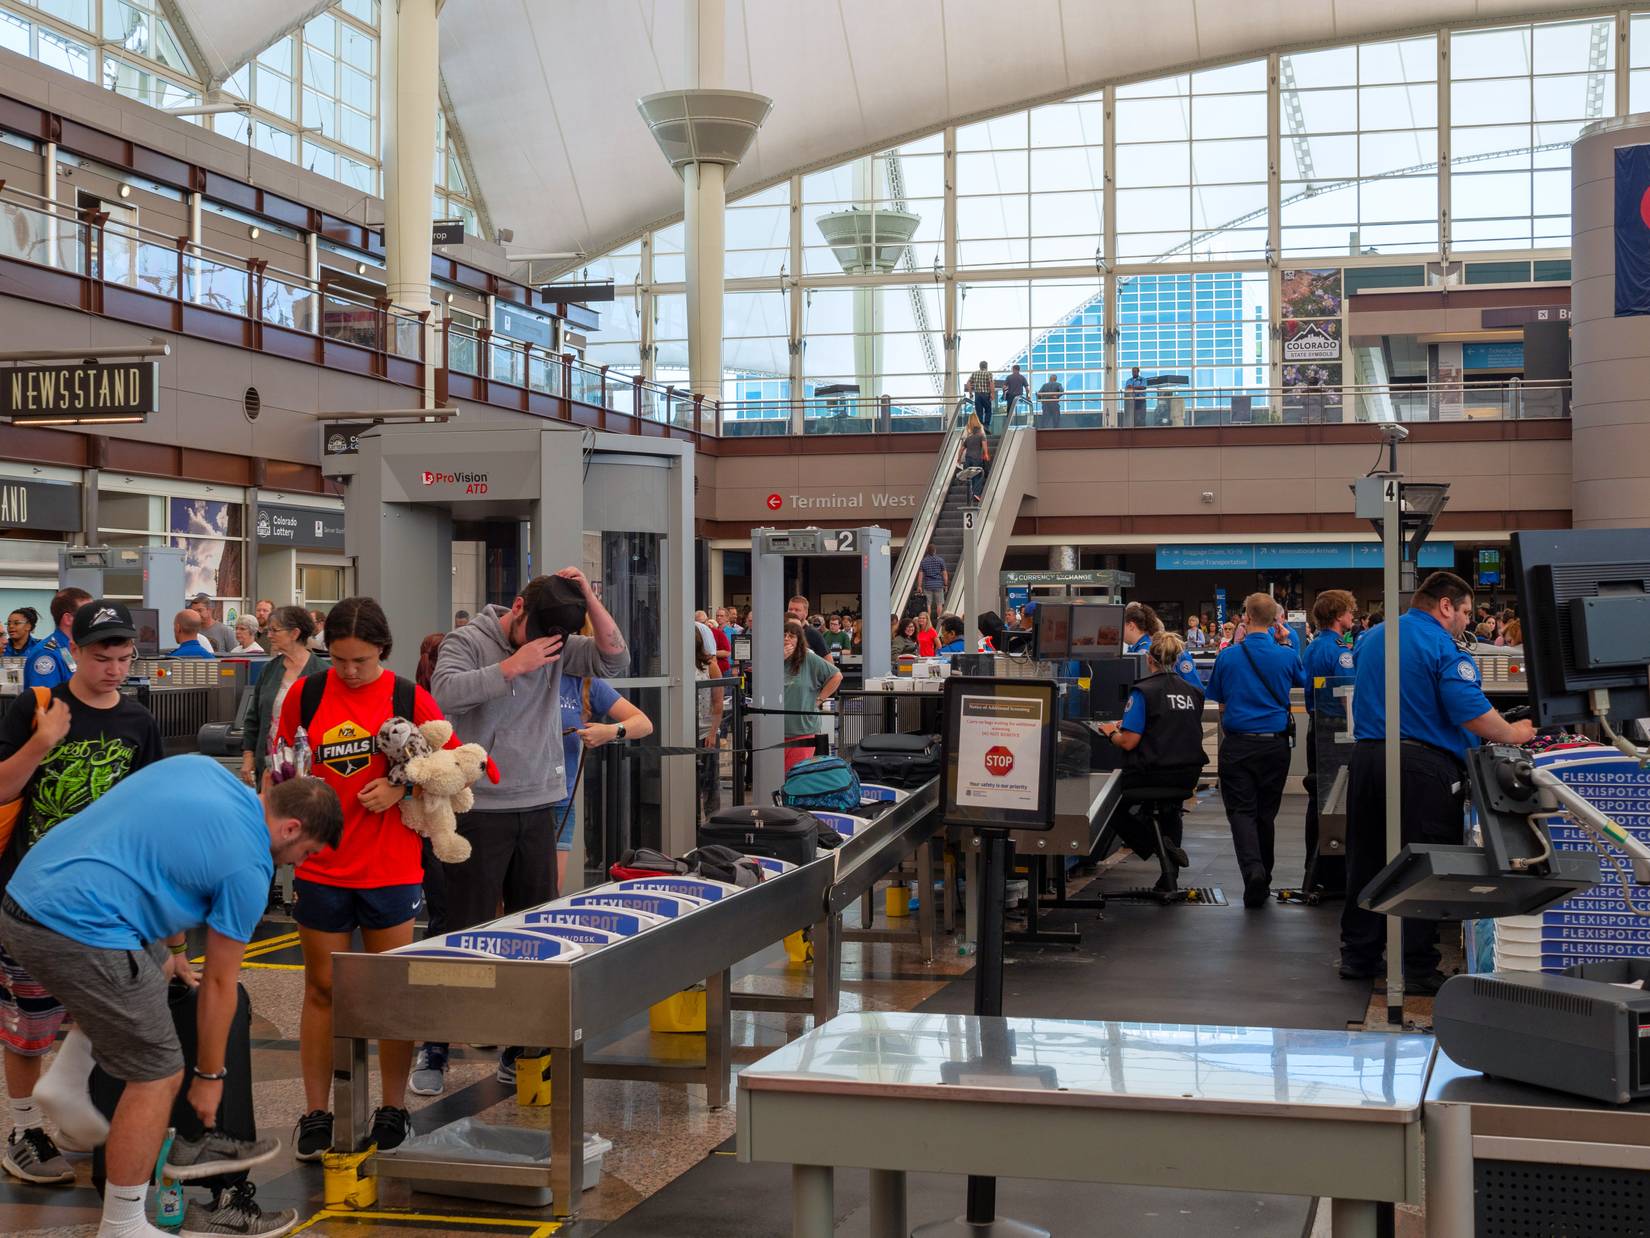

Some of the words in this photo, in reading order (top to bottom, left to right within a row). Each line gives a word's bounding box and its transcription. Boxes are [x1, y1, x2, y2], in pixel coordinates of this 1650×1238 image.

[1287, 341, 1337, 350] COLORADO
[12, 368, 140, 409] NEWSSTAND
[436, 472, 488, 483] ProVision
[465, 483, 488, 494] ATD
[1386, 481, 1395, 501] 4
[790, 492, 863, 508] Terminal
[872, 493, 916, 507] West
[273, 515, 297, 527] Colorado
[966, 513, 973, 528] 3
[273, 526, 294, 540] Lottery
[839, 531, 853, 551] 2
[1166, 694, 1195, 710] TSA
[324, 740, 370, 758] FINALS
[986, 755, 1013, 767] STOP
[460, 935, 541, 957] FLEXISPOT
